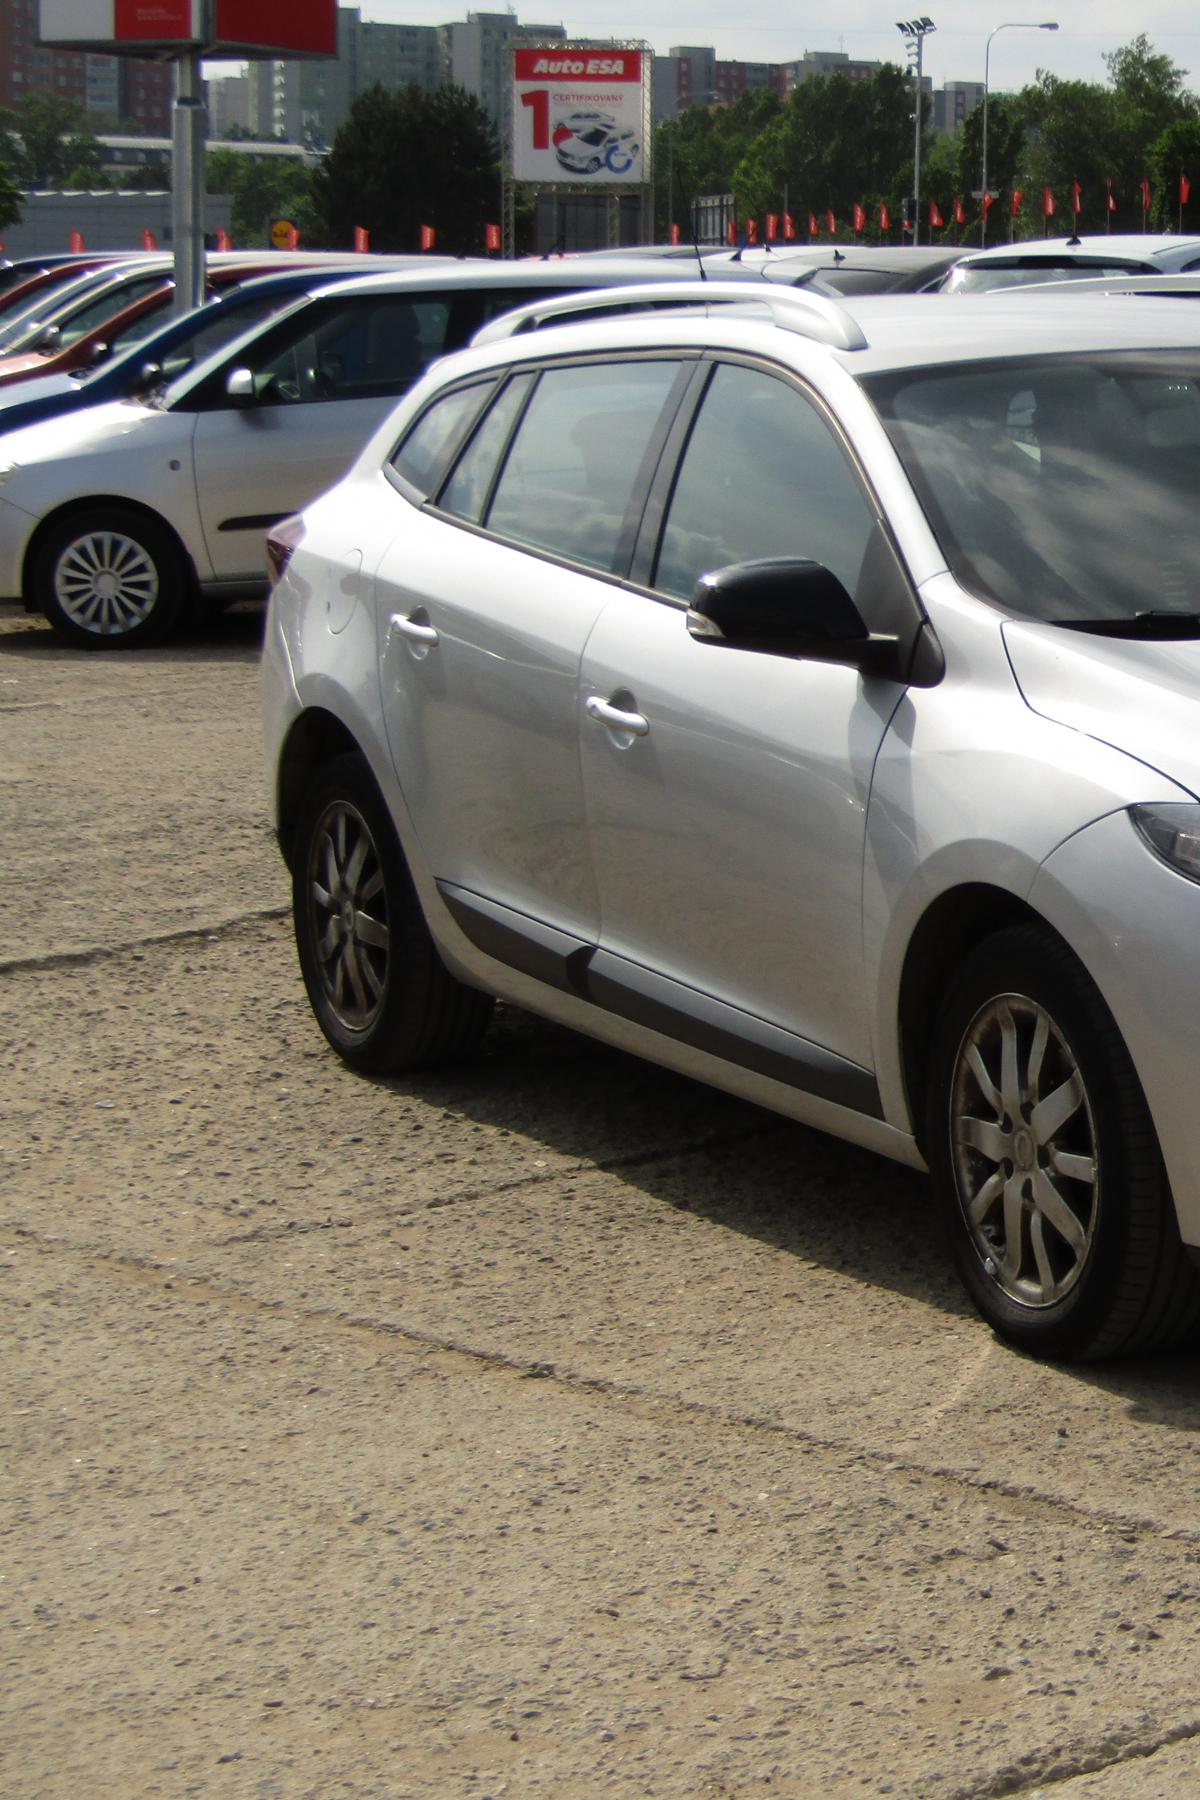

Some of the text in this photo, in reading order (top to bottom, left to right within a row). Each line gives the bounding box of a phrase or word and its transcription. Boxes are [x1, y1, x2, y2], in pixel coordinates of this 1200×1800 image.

[533, 58, 625, 75] Auto ESA
[520, 90, 549, 150] 1
